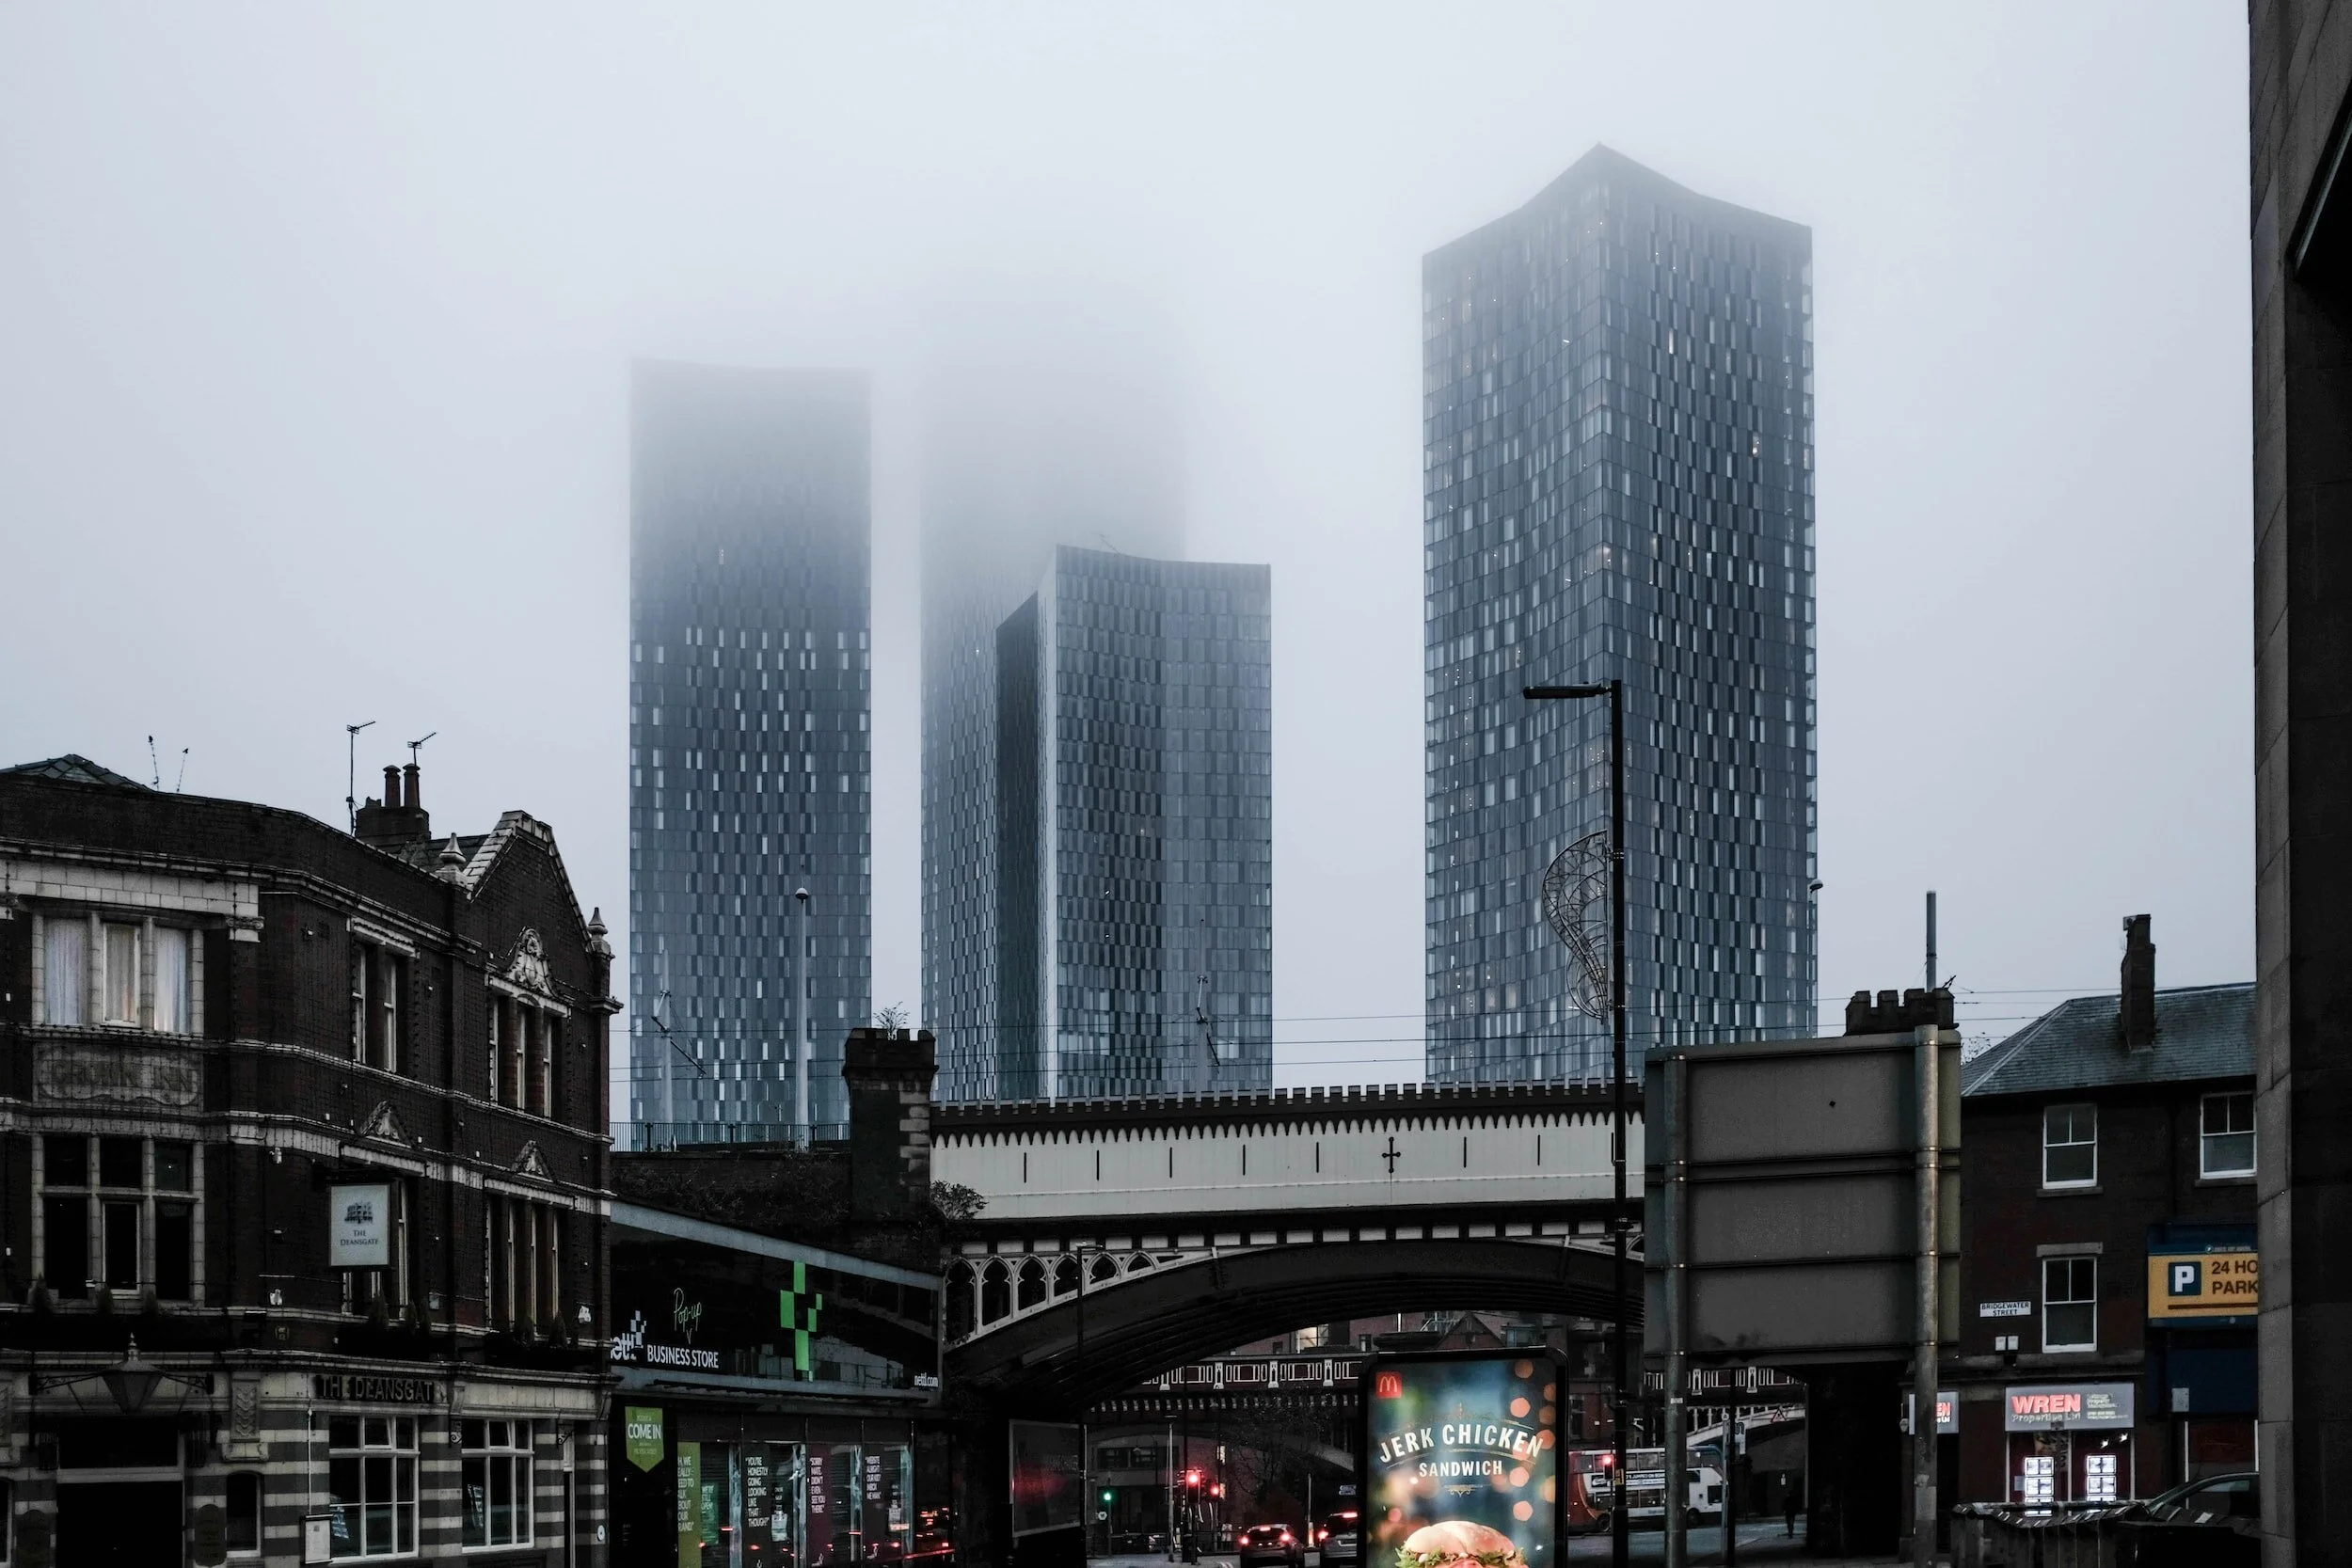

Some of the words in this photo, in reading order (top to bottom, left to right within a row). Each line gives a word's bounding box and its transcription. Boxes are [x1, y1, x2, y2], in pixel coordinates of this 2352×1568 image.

[340, 1238, 379, 1246] DEANSGATE
[2211, 1260, 2230, 1275] 24
[2234, 1259, 2258, 1274] HO
[2212, 1279, 2258, 1294] PARK
[673, 1287, 703, 1332] Pop-up
[1981, 1301, 2029, 1309] BRIDGEWATER
[646, 1343, 691, 1366] BUSINESS
[691, 1348, 720, 1370] STORE
[914, 1371, 939, 1387] nettl.com
[1936, 1402, 1951, 1417] EN
[2010, 1393, 2082, 1414] WREN
[2011, 1413, 2063, 1423] Properties
[628, 1423, 652, 1439] COME
[652, 1423, 661, 1439] IN
[1379, 1427, 1435, 1464] JERK
[1442, 1423, 1544, 1458] CHICKEN
[677, 1466, 691, 1477] EALLY
[747, 1466, 769, 1476] HONESTLY
[1419, 1460, 1503, 1479] SANDWICH
[747, 1477, 762, 1486] GOING
[747, 1487, 767, 1497] LOOKING
[677, 1499, 691, 1510] BOUT
[747, 1497, 757, 1507] LIKE
[677, 1511, 689, 1521] OUR
